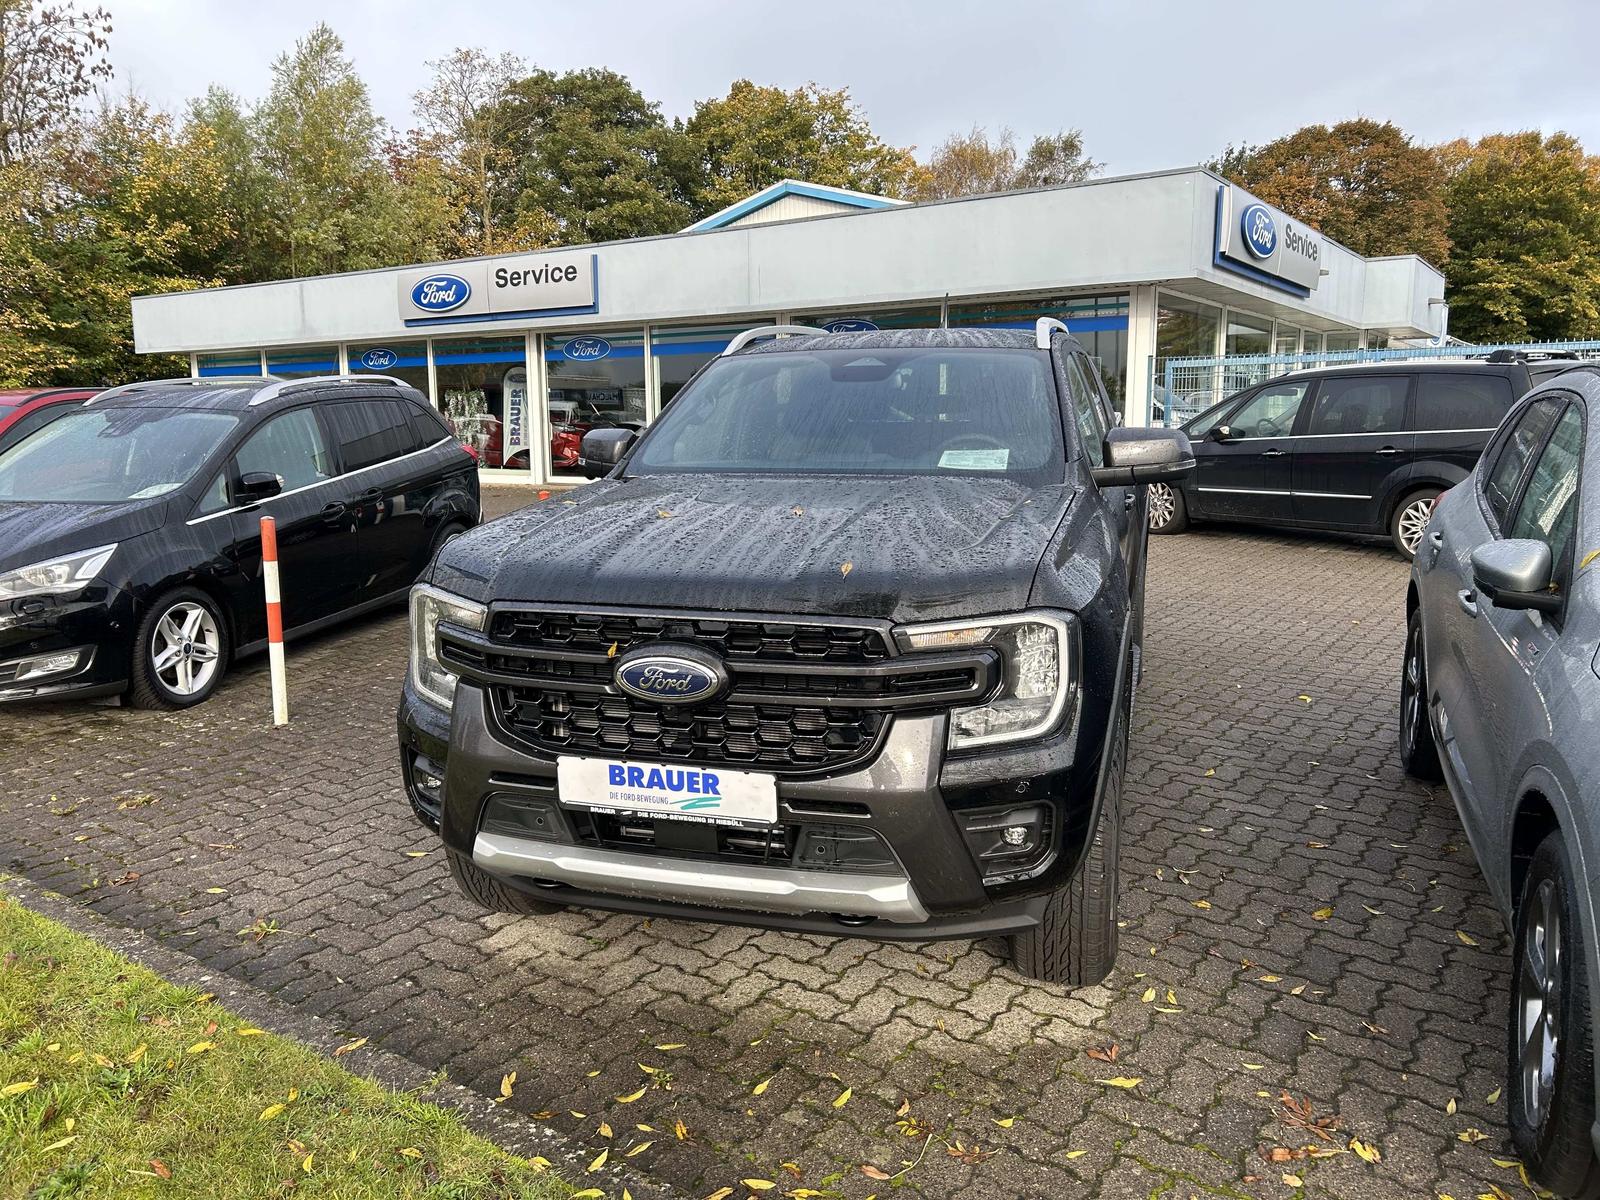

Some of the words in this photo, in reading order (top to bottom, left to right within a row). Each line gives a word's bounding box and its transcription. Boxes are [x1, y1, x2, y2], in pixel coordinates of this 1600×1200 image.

[1252, 211, 1273, 249] Ford
[1285, 223, 1318, 261] Service
[420, 281, 457, 304] Ford
[495, 263, 578, 288] Service
[368, 351, 390, 366] Ford
[573, 340, 601, 356] Ford
[510, 388, 522, 446] BRAUER
[639, 666, 692, 691] Ford
[608, 764, 721, 796] BRAUER
[609, 791, 619, 800] DIE
[590, 806, 616, 815] BRAUER
[637, 811, 649, 819] DIE
[650, 812, 706, 824] FORD-BEWEGUNG
[707, 817, 715, 825] IN
